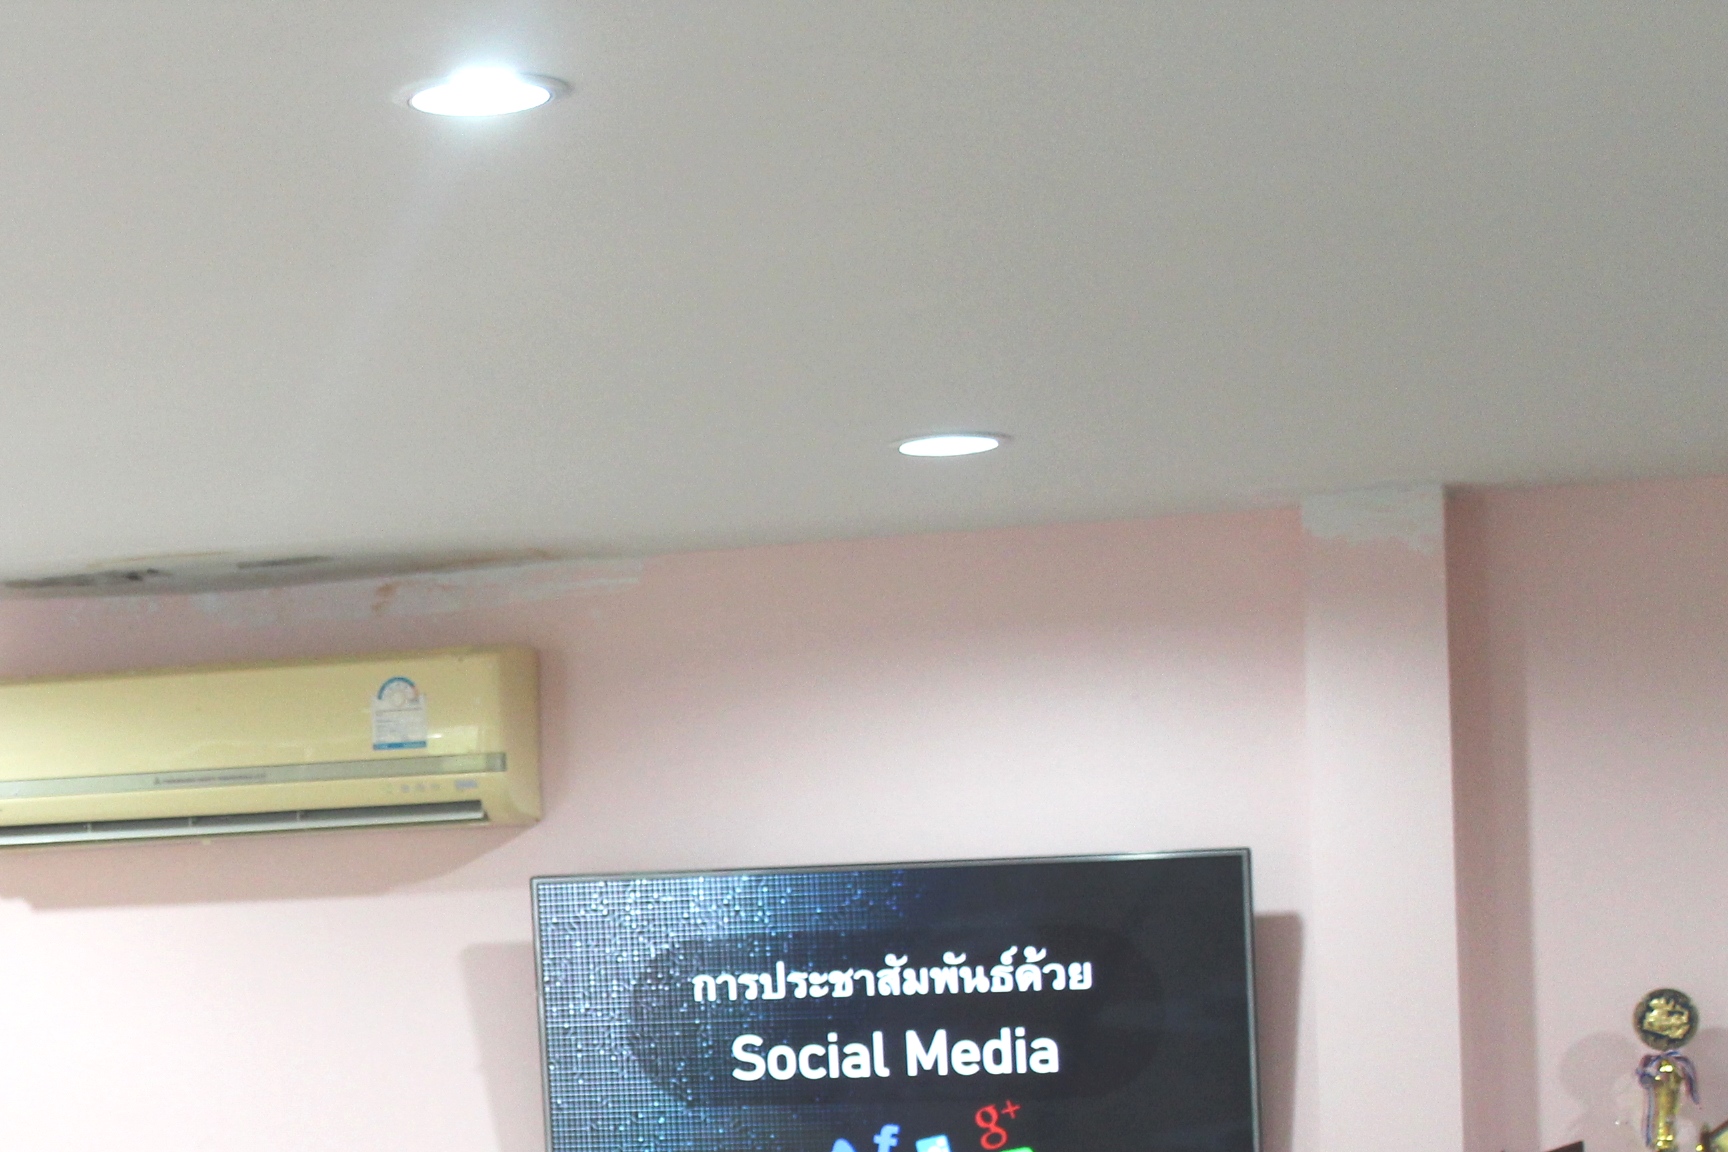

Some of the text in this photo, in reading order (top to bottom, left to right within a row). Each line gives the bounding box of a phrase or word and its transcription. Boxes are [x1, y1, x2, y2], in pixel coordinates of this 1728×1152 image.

[692, 945, 1092, 1002] การประชาสัมพันธ์ด้วย
[731, 1026, 1059, 1081] Social Media
